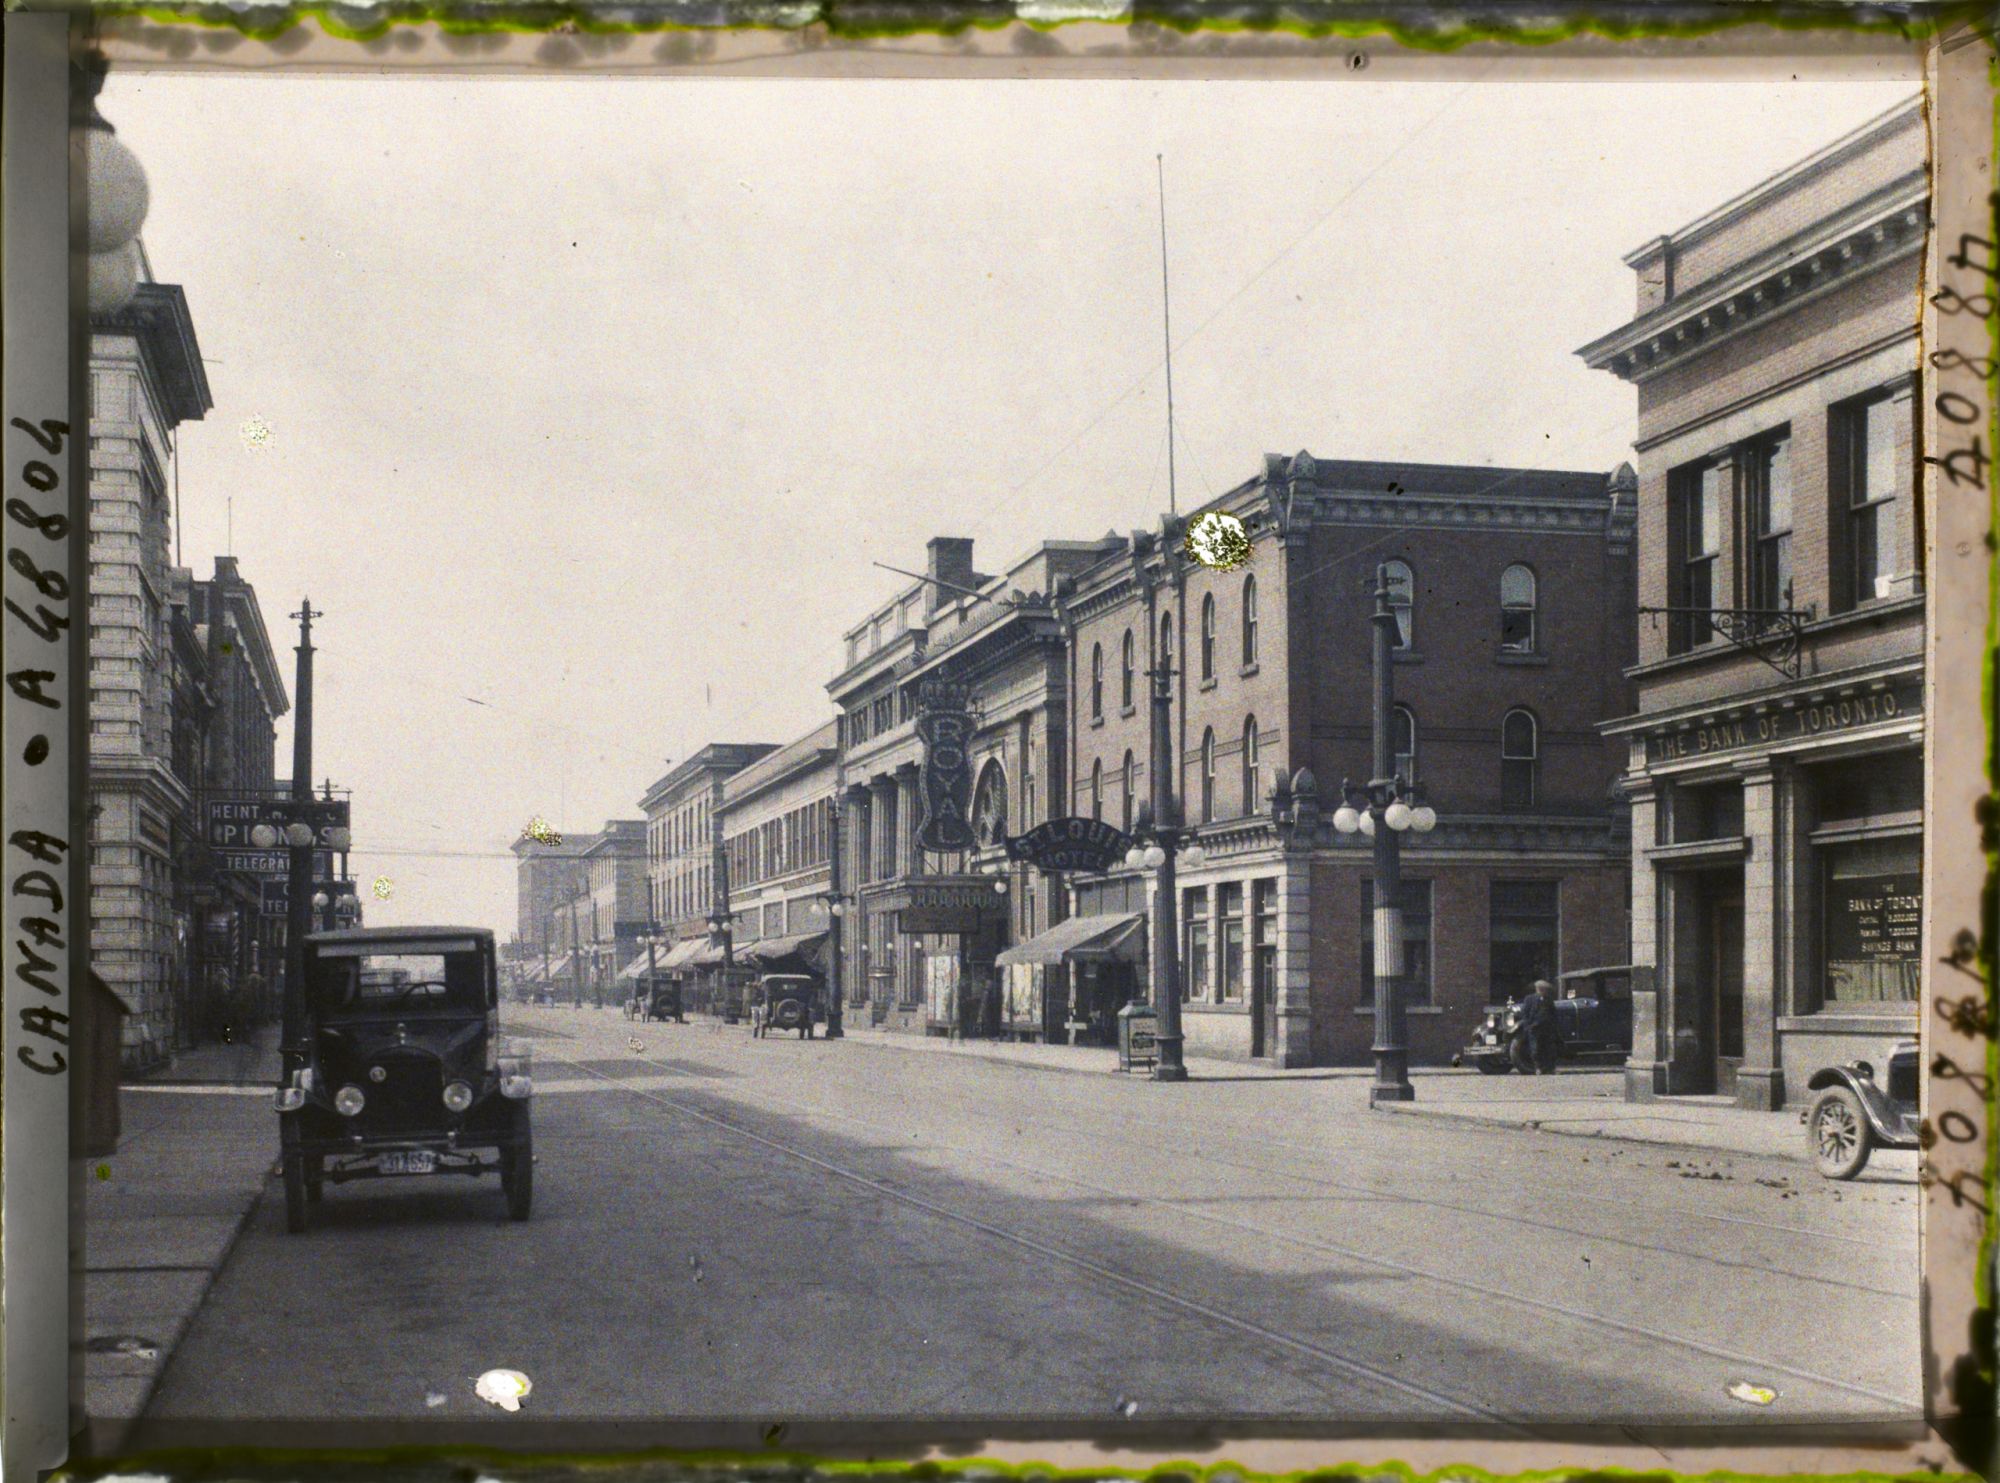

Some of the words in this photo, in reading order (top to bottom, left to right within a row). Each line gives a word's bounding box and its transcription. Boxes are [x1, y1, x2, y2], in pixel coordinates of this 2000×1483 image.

[1656, 735, 1688, 759] THE
[1699, 722, 1746, 750] BANK
[1759, 715, 1780, 740] OF
[932, 718, 965, 845] ROYAL
[1039, 850, 1105, 869] HOTEL
[1046, 819, 1133, 857] LOUIS
[9, 829, 70, 1076] CANADA
